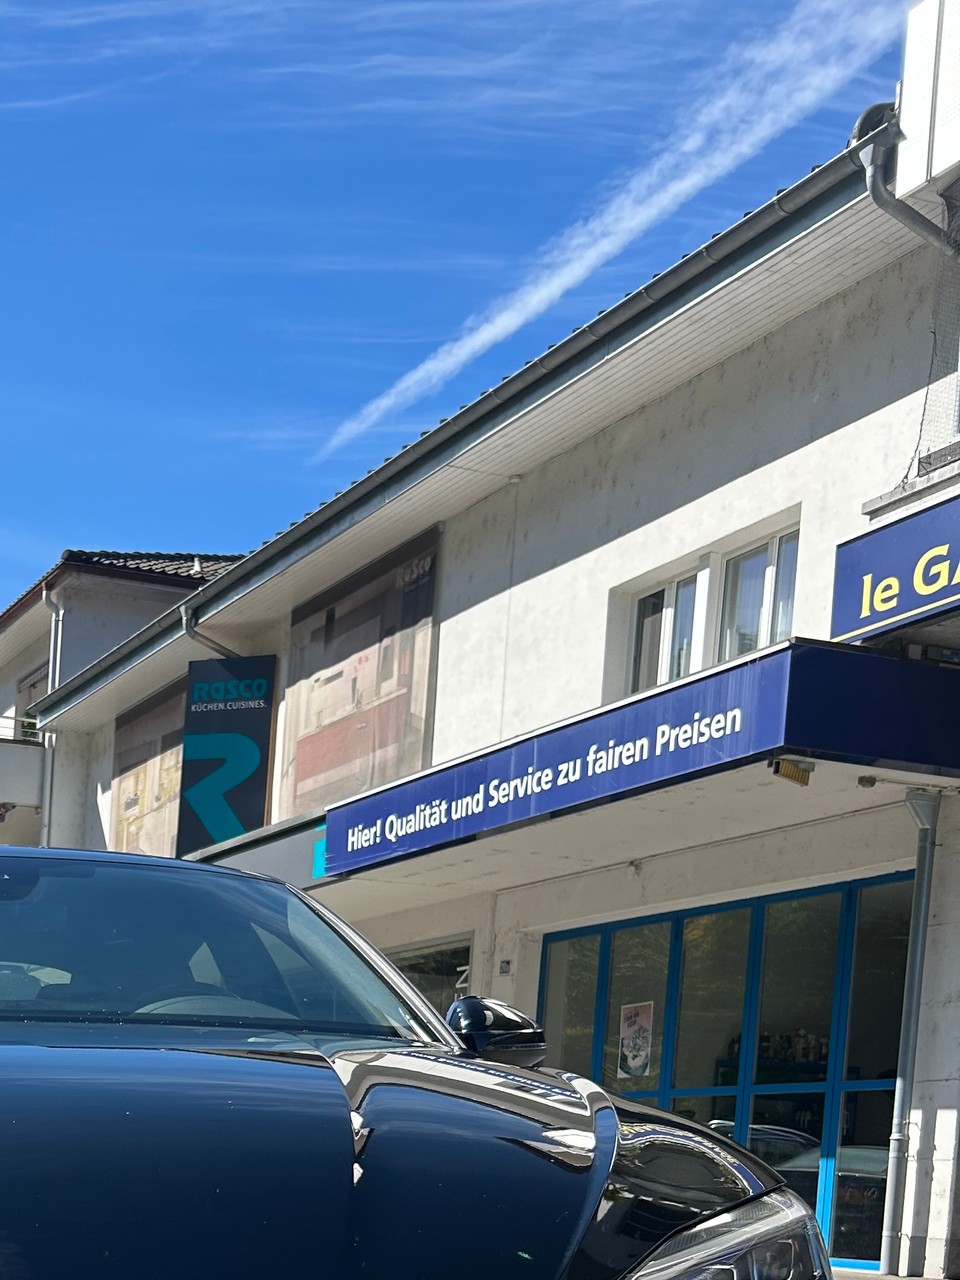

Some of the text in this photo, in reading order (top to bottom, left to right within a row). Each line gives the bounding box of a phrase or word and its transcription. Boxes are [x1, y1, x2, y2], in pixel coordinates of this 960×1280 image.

[859, 543, 960, 619] le G
[347, 819, 382, 852] Hier!
[384, 799, 448, 842] Qualität
[451, 784, 485, 821] und
[488, 766, 553, 808] Service
[557, 758, 581, 786] zu
[586, 737, 649, 777] fairen
[655, 707, 742, 756] Preisen
